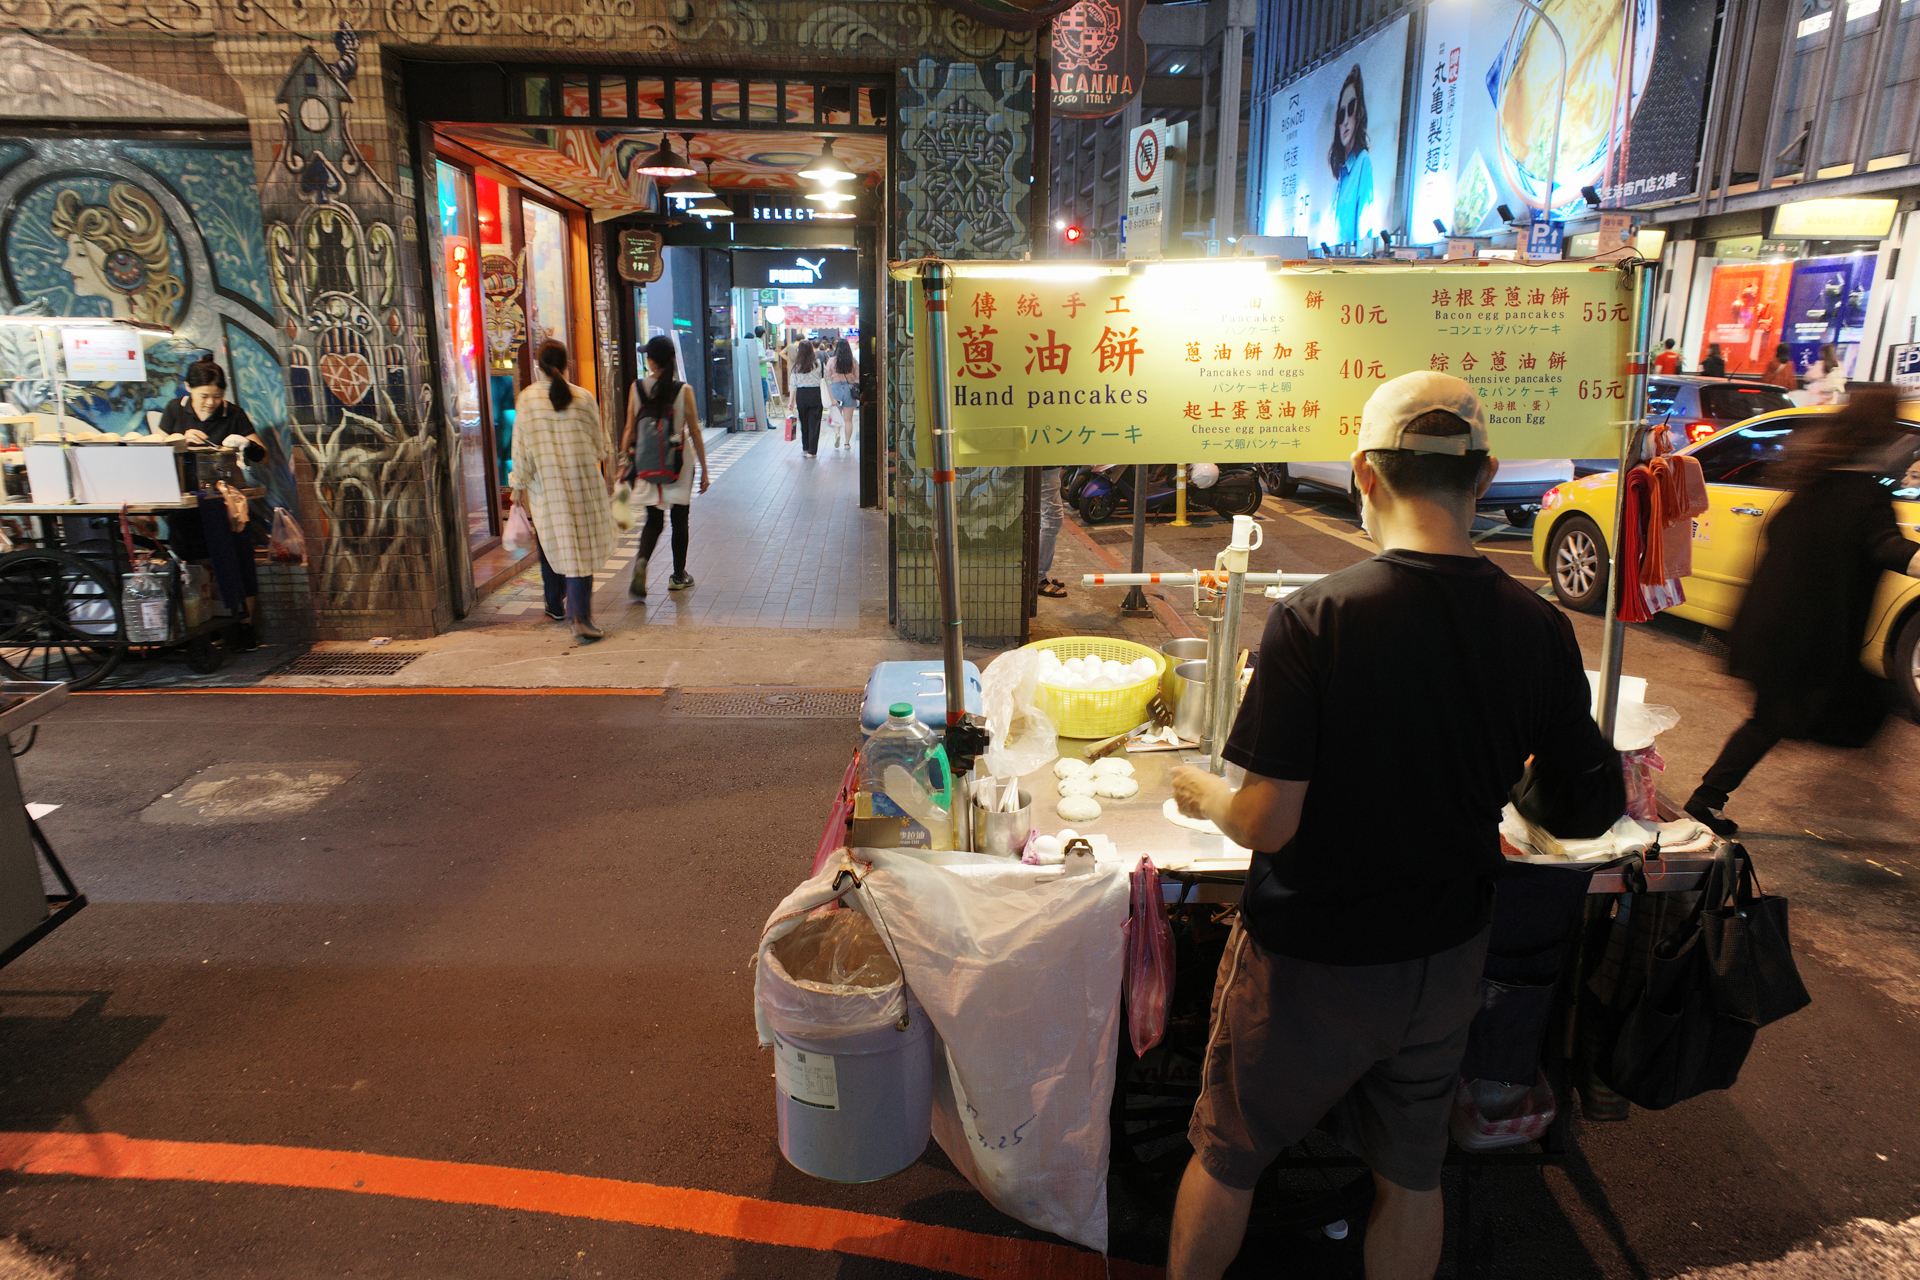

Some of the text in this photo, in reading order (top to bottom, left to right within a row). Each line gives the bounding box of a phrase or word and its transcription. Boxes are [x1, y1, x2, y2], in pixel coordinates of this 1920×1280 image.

[1032, 73, 1133, 94] ACANNA
[1052, 94, 1112, 106] 1960 ITALY
[753, 207, 815, 220] SELECT
[1531, 223, 1551, 245] P
[768, 269, 814, 283] PUMA
[970, 291, 1131, 319] 傳統手工
[1431, 286, 1630, 322] 培根蛋蔥油餅 55元
[1221, 313, 1285, 323] Pancakes
[1340, 304, 1388, 325] 30元
[1435, 309, 1565, 320] Bacon egg pancakes
[957, 325, 1145, 379] 蔥油餅
[1184, 341, 1387, 379] 蔥油餅加蛋 40元
[1200, 367, 1305, 378] Pancakes and eggs
[1430, 351, 1625, 400] 綜合蔥油餅 65元
[1462, 374, 1562, 384] ehensive pancakes
[1212, 381, 1292, 393] パンケーキと卵
[1474, 386, 1559, 397] なパンケーキ
[954, 384, 1148, 409] Hand pancakes
[1182, 399, 1321, 420] 起士蛋蔥油餅
[1489, 413, 1546, 425] Bacon Egg
[1030, 424, 1144, 446] パンケーキ
[1192, 423, 1311, 434] Cheese egg pancakes
[1201, 438, 1302, 450] チーズ卵パンケーキ
